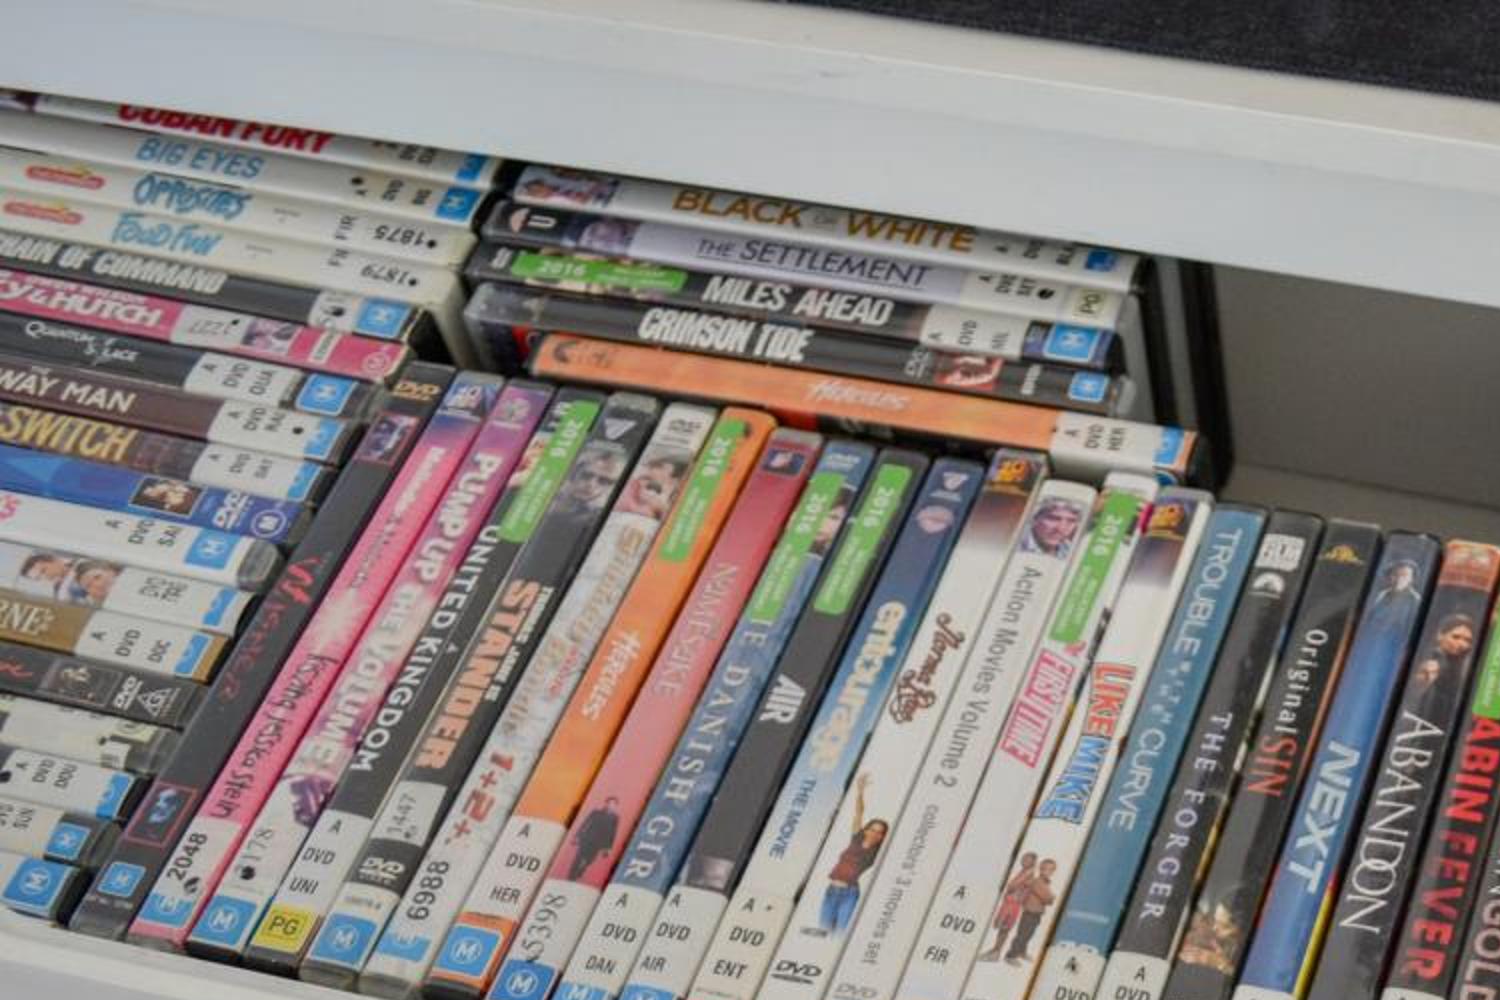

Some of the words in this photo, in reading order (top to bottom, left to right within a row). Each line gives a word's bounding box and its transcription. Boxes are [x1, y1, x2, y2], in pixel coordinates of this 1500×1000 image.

[136, 137, 186, 165] BIG
[191, 147, 265, 179] EYES
[374, 225, 425, 245] 1875
[672, 189, 802, 227] BLACK
[846, 211, 977, 252] WHITE
[93, 250, 228, 295] COMMAND
[540, 260, 587, 277] 2016
[703, 275, 792, 312] MILES
[792, 287, 895, 326] AHEAD
[699, 239, 731, 257] THE
[740, 239, 932, 286] SETTLEMENT
[48, 290, 164, 326] HUTCH
[638, 307, 755, 357] CRIMSON
[754, 322, 814, 362] TIDE
[61, 382, 136, 414] MAN
[0, 405, 139, 462] SWITCH
[438, 452, 504, 539] PUMP
[414, 537, 453, 584] UP
[431, 524, 500, 630] UNITED
[1000, 565, 1044, 630] Action
[1172, 528, 1243, 656] TROUBLE
[413, 578, 541, 770] STANDER
[972, 629, 1018, 694] Movies
[1274, 628, 1329, 735] Original
[350, 636, 443, 772] KINGDOM
[760, 672, 807, 724] AIR
[1082, 662, 1137, 736] LIKE
[664, 665, 751, 807] DANISH
[945, 697, 990, 771] Volume
[1002, 701, 1051, 769] TIME
[1195, 711, 1234, 773] THE
[933, 771, 959, 788] 2
[1033, 735, 1111, 826] MIKE
[1108, 728, 1166, 833] CURVE
[1247, 735, 1299, 797] SIN
[624, 814, 675, 880] GIR
[1288, 740, 1362, 895] NEXT
[1339, 710, 1446, 936] ABANDON
[167, 833, 208, 880] 2048
[302, 847, 336, 866] DVD
[505, 853, 541, 873] DVD
[1139, 788, 1205, 920] FORGER
[406, 860, 449, 922] 6988
[1406, 830, 1482, 982] FEVER
[601, 922, 637, 944] DVD
[656, 922, 691, 942] DVD
[729, 927, 765, 947] DVD
[940, 913, 976, 935] DVD
[713, 959, 748, 979] ENT
